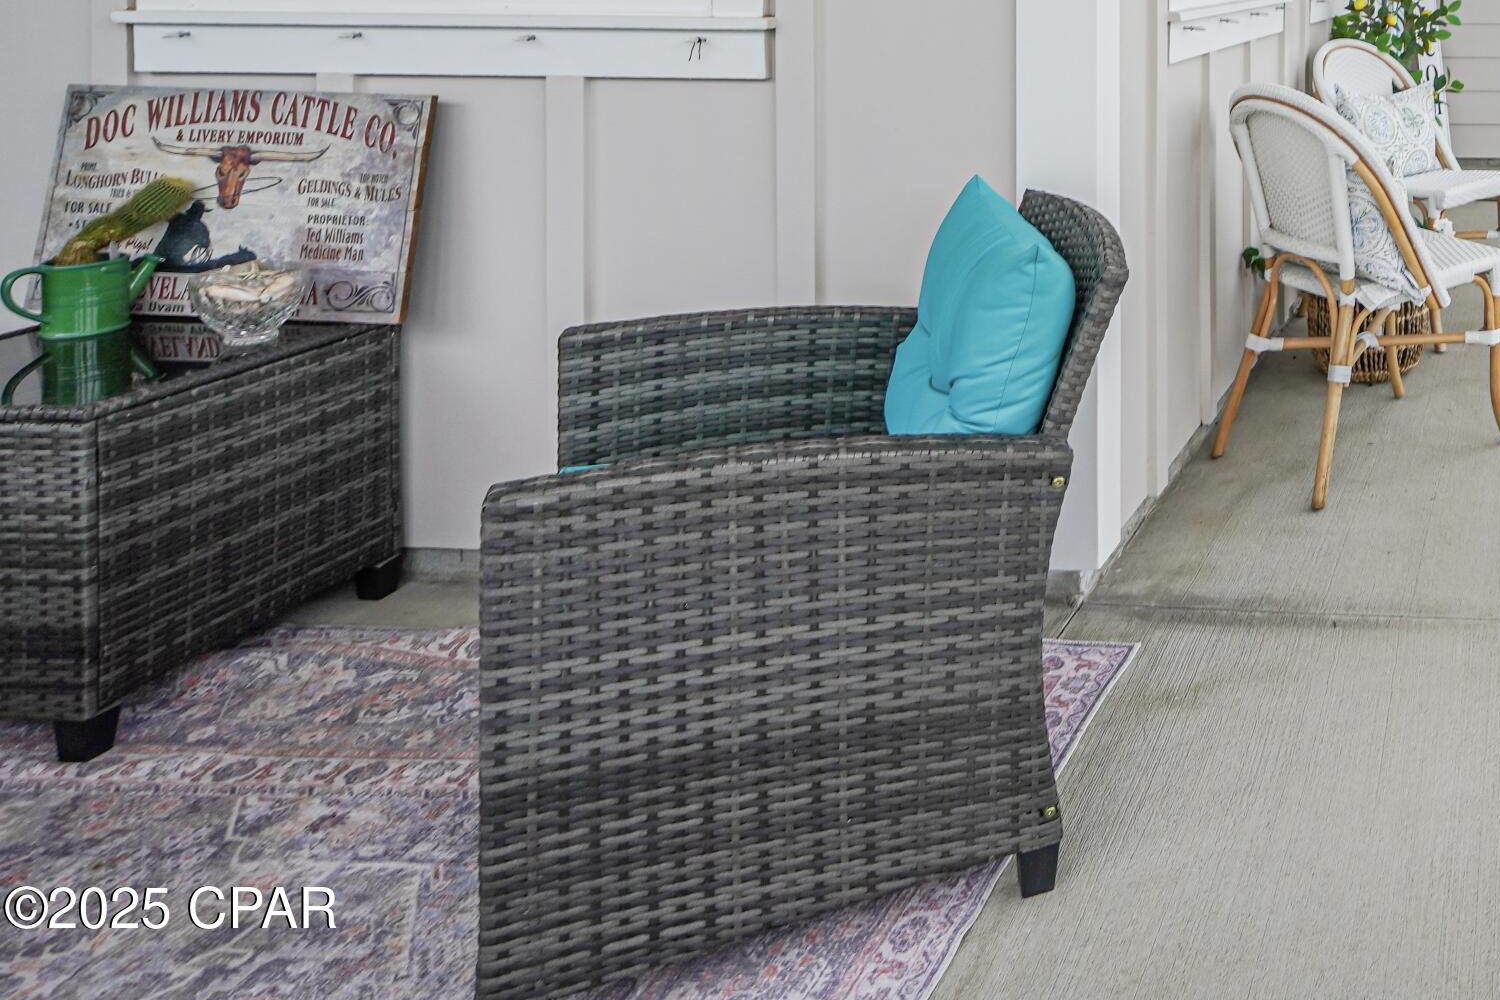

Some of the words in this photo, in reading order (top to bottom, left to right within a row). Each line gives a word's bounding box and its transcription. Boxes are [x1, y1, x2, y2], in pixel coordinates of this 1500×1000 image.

[84, 103, 137, 151] DOC
[147, 89, 263, 133] WILLIAMS
[271, 90, 358, 141] CATTLE
[364, 113, 397, 160] CO.
[176, 129, 184, 142] &
[188, 129, 235, 143] LIVERY
[237, 130, 304, 146] EMPORIUM
[297, 179, 352, 198] GELDINGS
[64, 201, 84, 213] FOR
[307, 197, 319, 207] FOR
[307, 214, 370, 226] PROPRIETOR:
[306, 228, 322, 243] Ted
[324, 228, 364, 245] Williams
[300, 244, 341, 260] Medicine
[343, 246, 364, 262] Man
